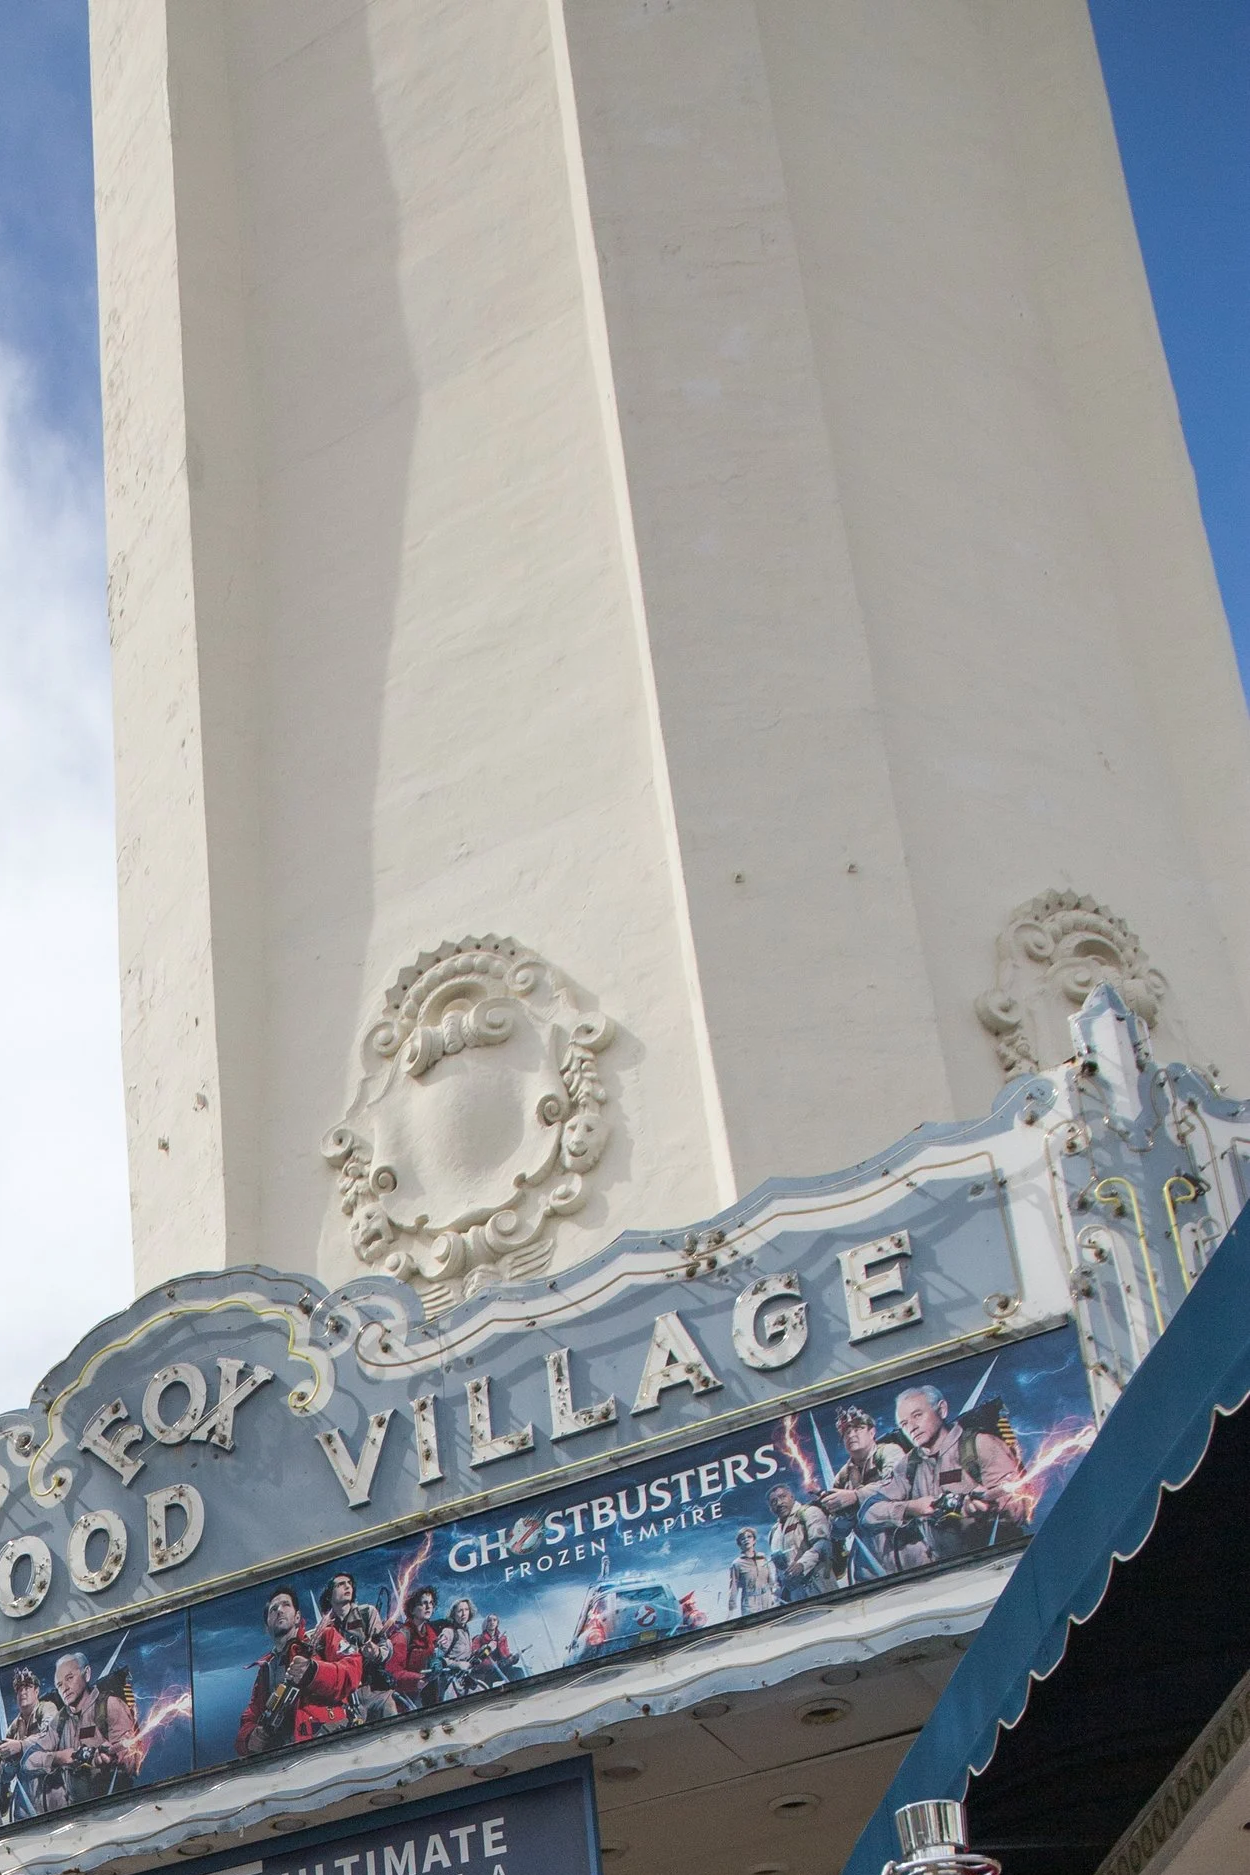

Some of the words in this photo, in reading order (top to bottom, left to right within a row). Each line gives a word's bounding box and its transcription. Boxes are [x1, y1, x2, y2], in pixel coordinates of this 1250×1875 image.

[77, 1358, 275, 1487] FOX
[315, 1229, 923, 1510] VILLAGE
[504, 1538, 607, 1582] FROZEN
[623, 1502, 723, 1546] EMPIRE
